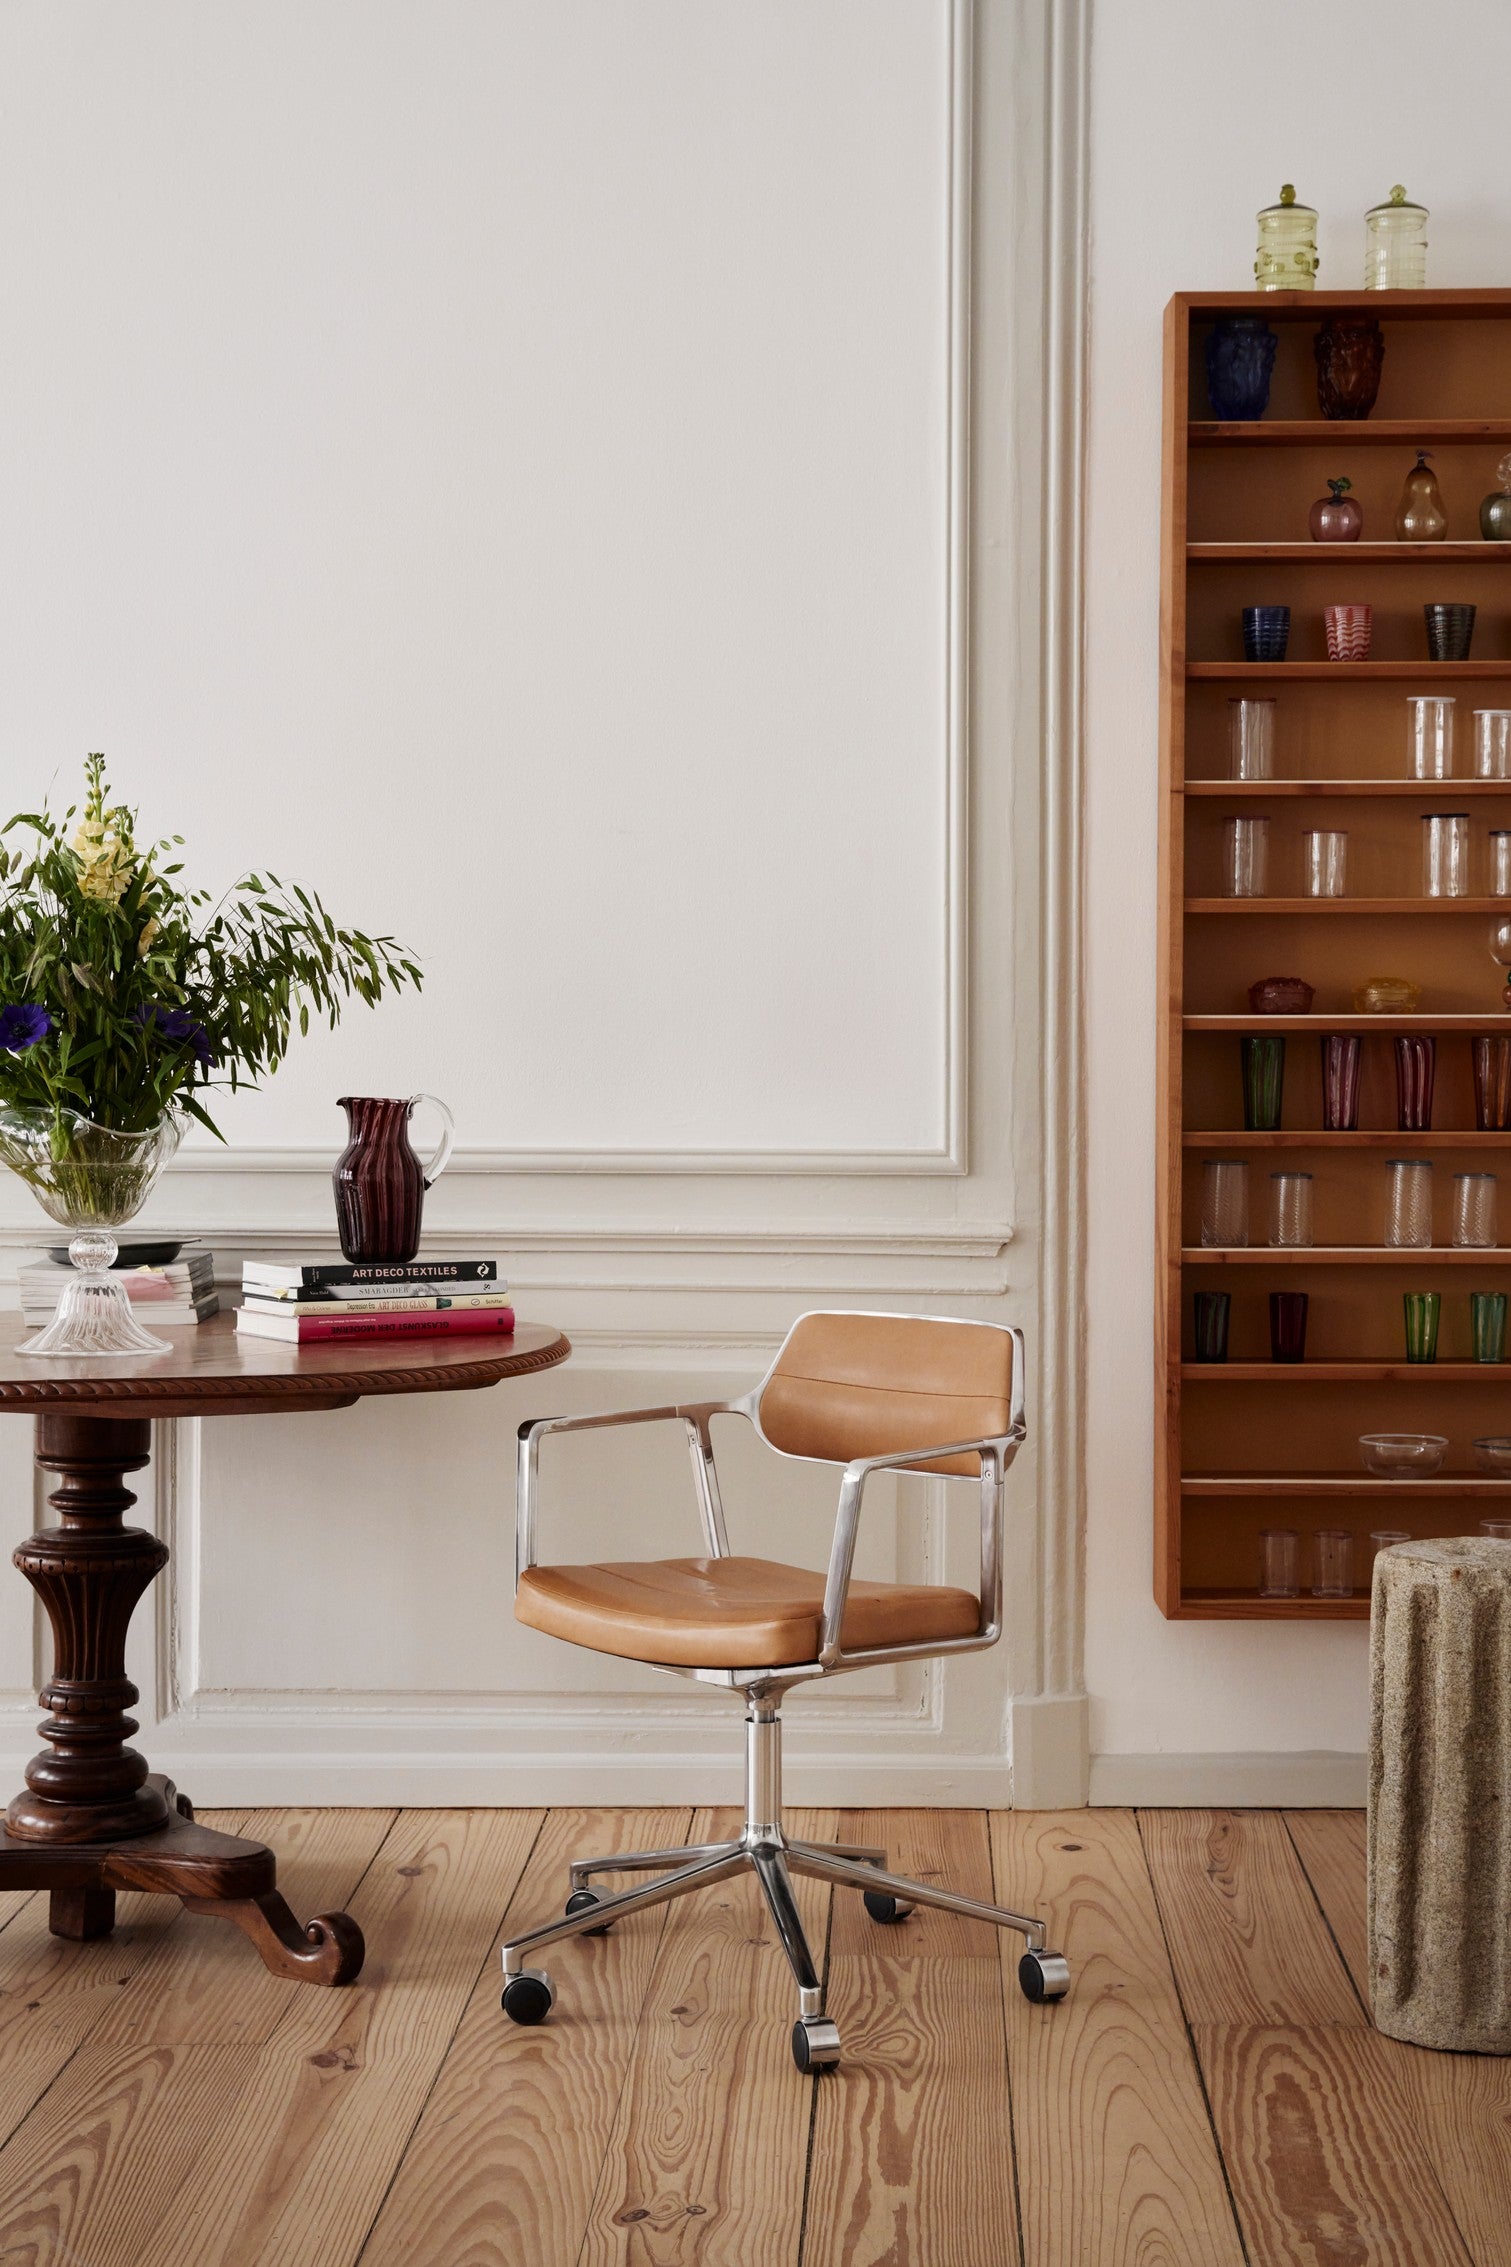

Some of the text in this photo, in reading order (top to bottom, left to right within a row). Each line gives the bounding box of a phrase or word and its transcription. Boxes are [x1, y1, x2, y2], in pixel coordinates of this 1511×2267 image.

[352, 1266, 458, 1278] ART DECO TEXTILES
[377, 1300, 390, 1311] ART
[331, 1320, 450, 1335] GLASKUNST DER MODERNE
